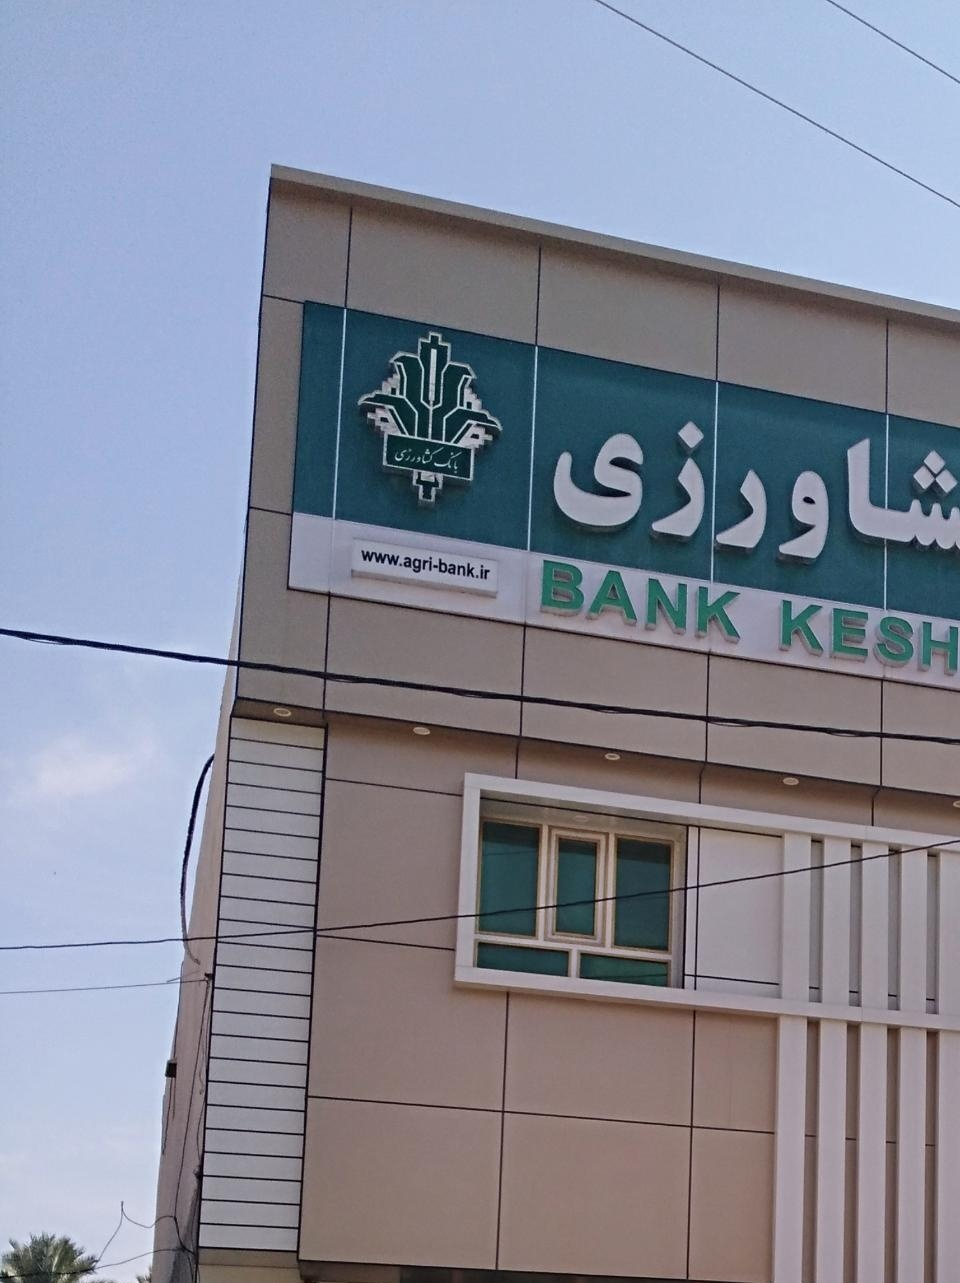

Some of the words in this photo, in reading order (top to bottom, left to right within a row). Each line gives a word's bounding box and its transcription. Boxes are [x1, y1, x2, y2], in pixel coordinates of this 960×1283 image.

[394, 446, 445, 465] کشاورزی
[434, 450, 463, 474] بانک
[360, 549, 491, 581] www.agri-bank.ir
[540, 558, 742, 643] BANK
